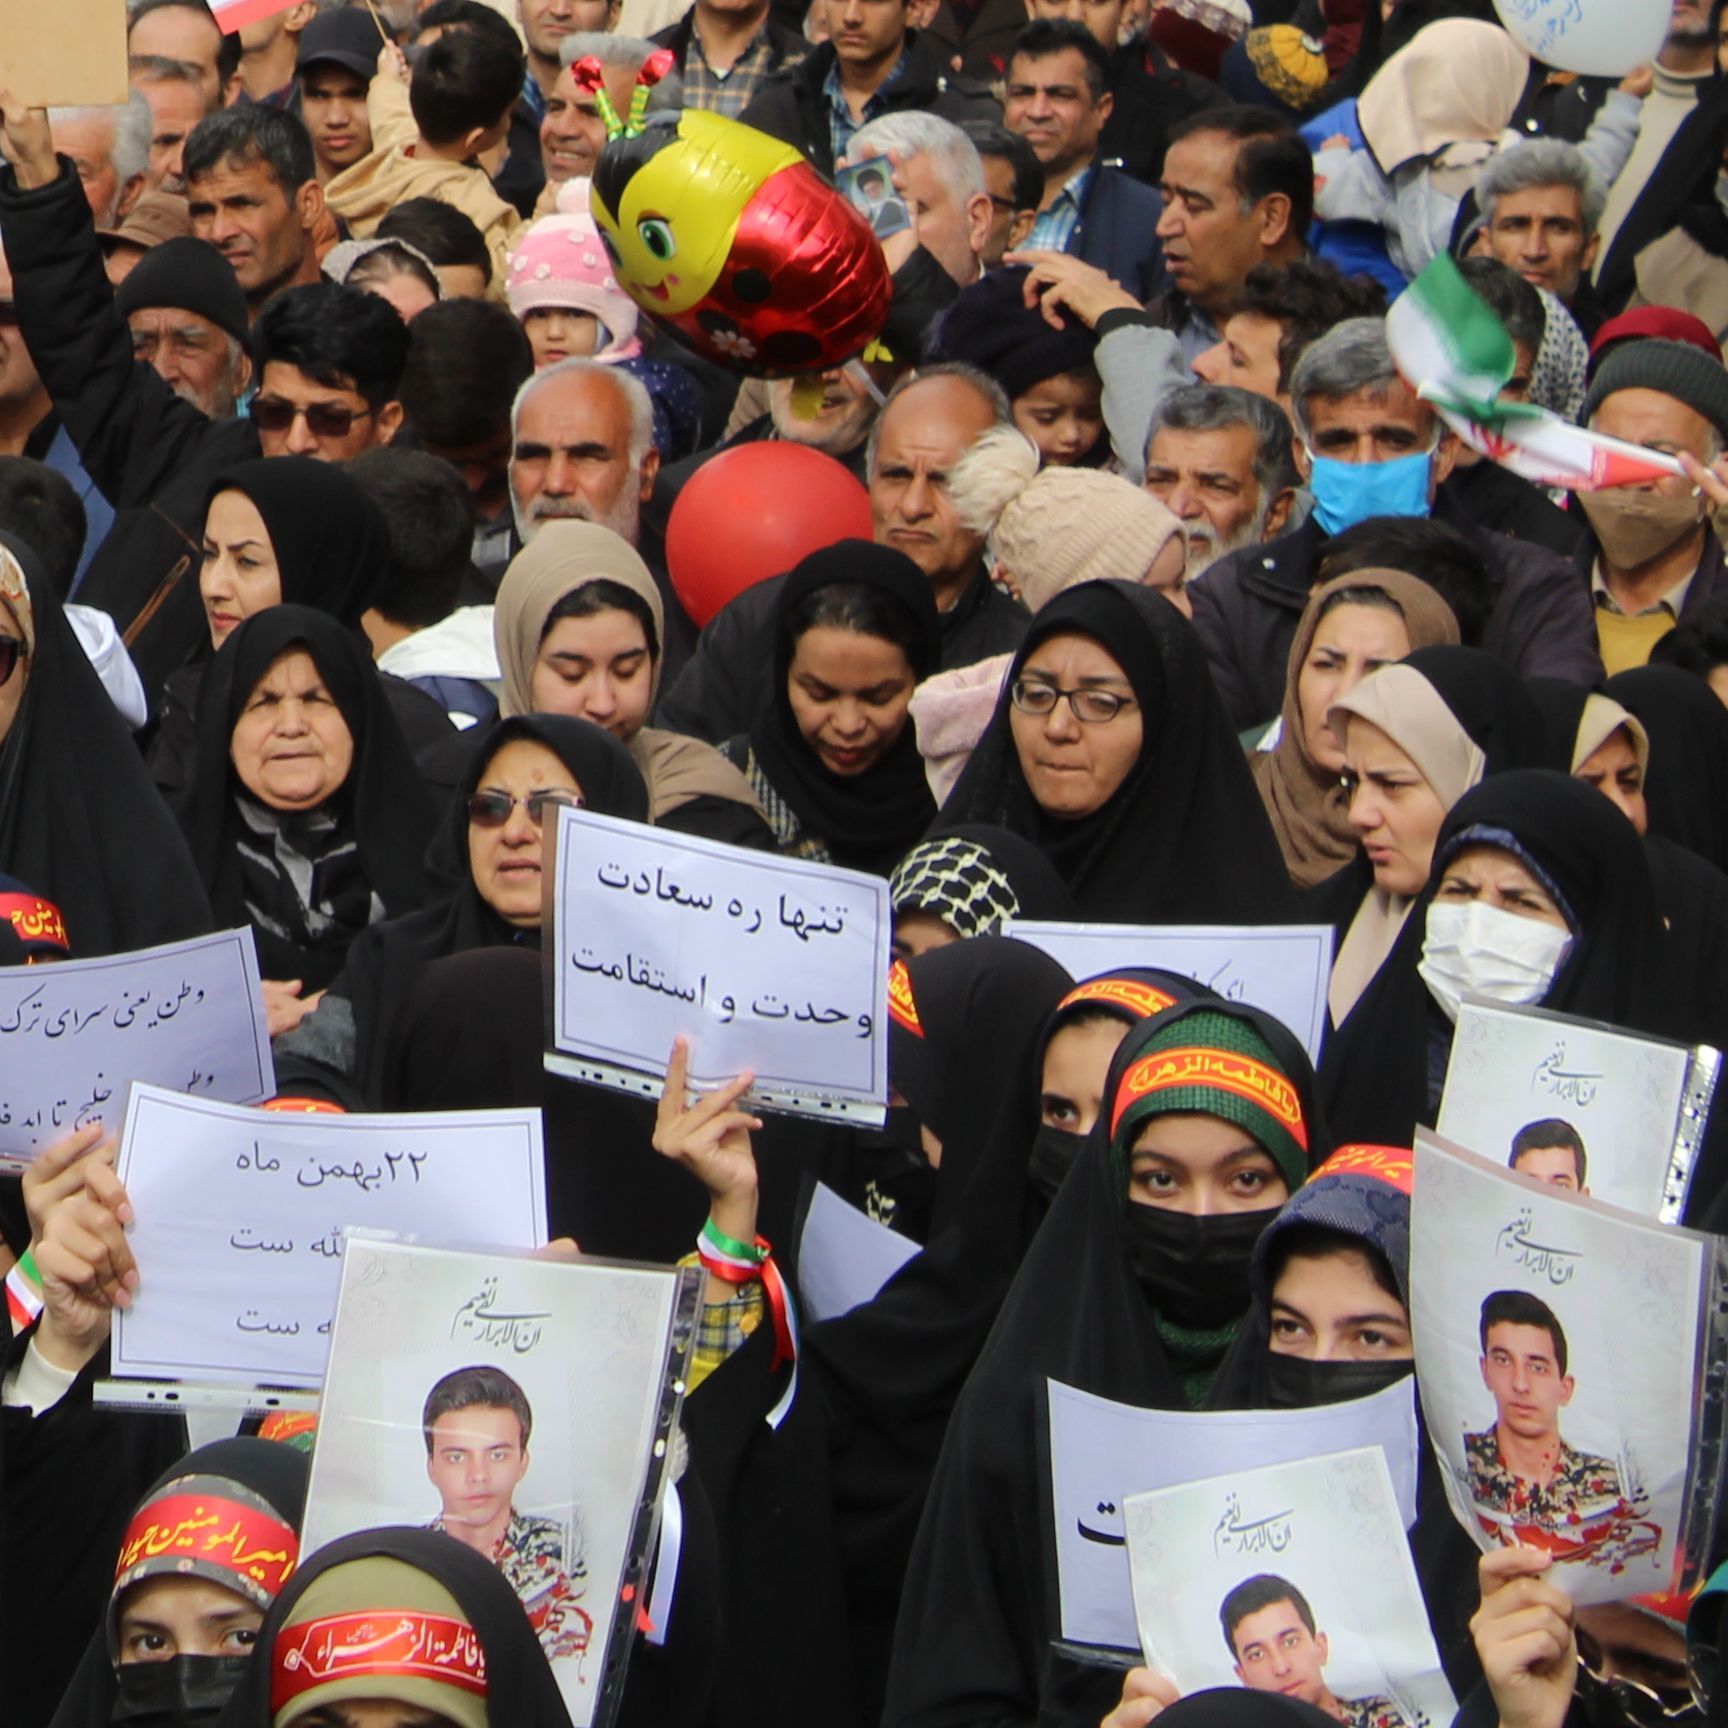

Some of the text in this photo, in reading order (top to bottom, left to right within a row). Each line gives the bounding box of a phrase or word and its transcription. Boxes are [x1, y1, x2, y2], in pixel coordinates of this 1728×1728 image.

[596, 860, 849, 942] تنها ره سعادت
[0, 982, 47, 1033] ترک
[113, 990, 159, 1028] یعنی
[157, 980, 205, 1019] وطن
[571, 944, 873, 1039] وحدت و استقامت
[44, 1002, 108, 1038] سرای
[236, 1140, 281, 1173] ماه
